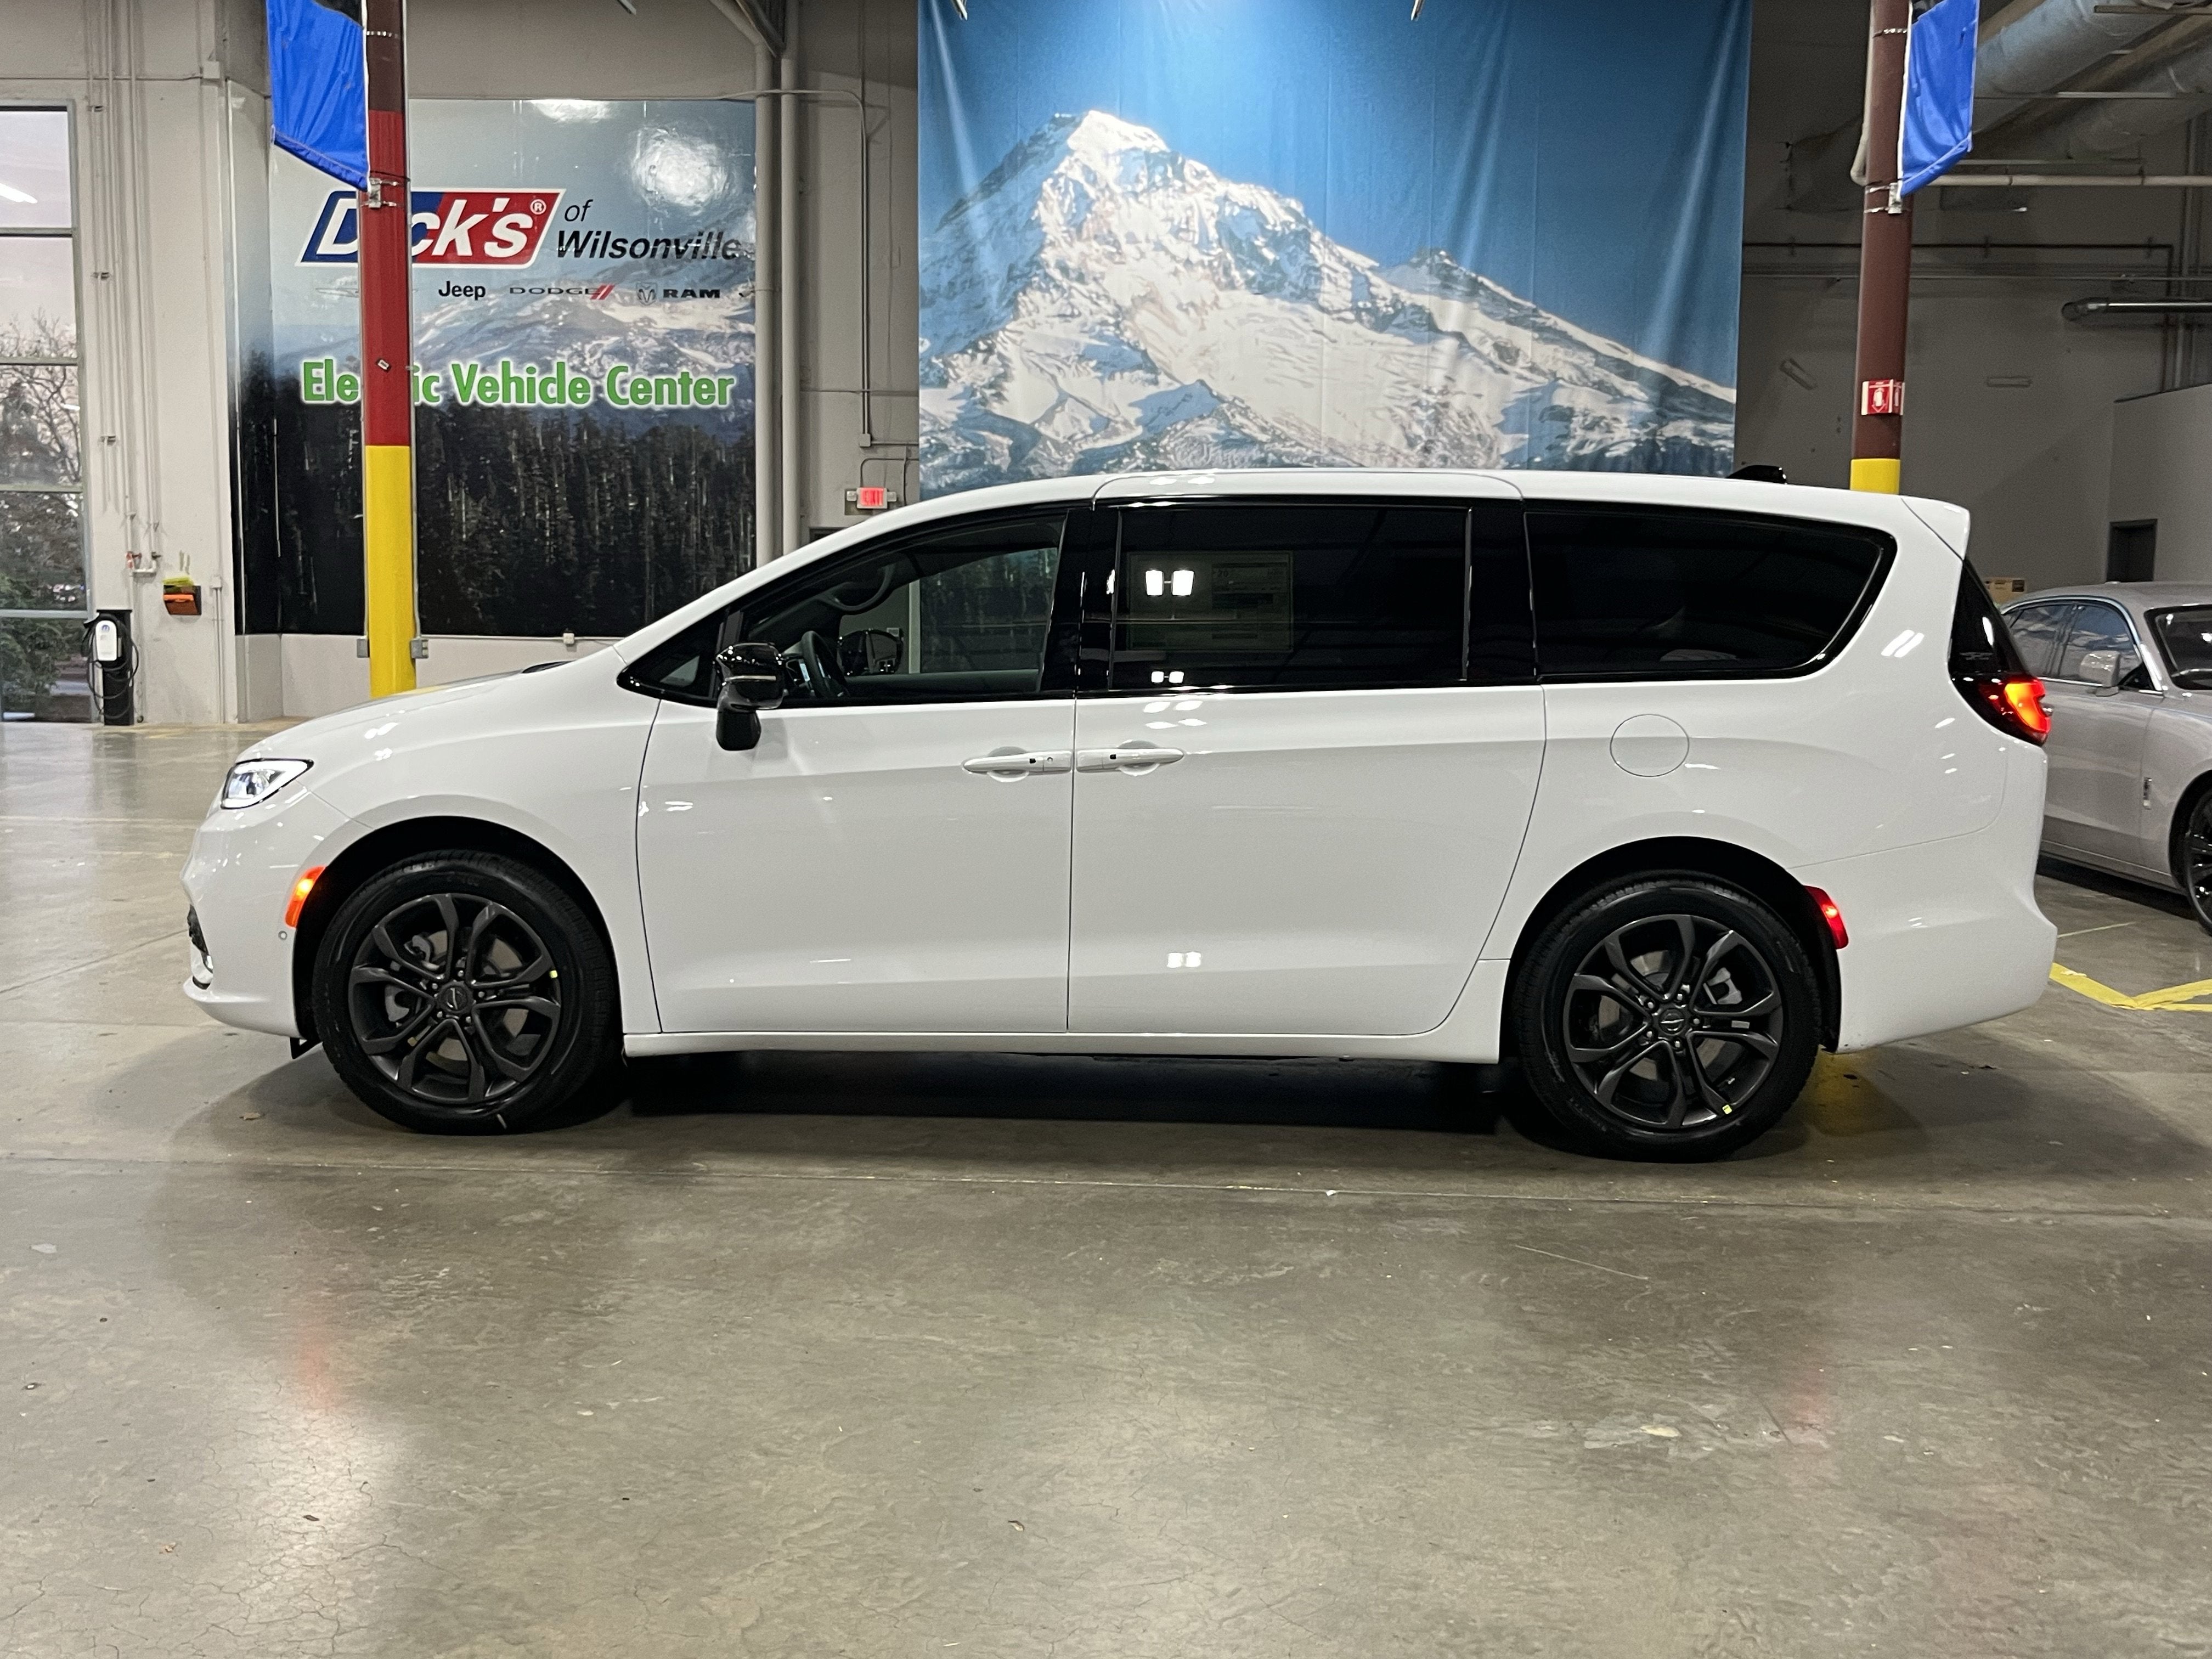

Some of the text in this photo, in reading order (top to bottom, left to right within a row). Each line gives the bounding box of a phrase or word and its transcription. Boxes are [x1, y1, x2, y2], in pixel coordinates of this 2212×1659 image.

[565, 199, 593, 222] of
[316, 198, 533, 257] Dck's
[557, 230, 742, 259] Wilsonville
[438, 281, 486, 300] Jeep
[663, 289, 720, 298] RAM
[303, 359, 734, 405] Eleic Vehicle Center
